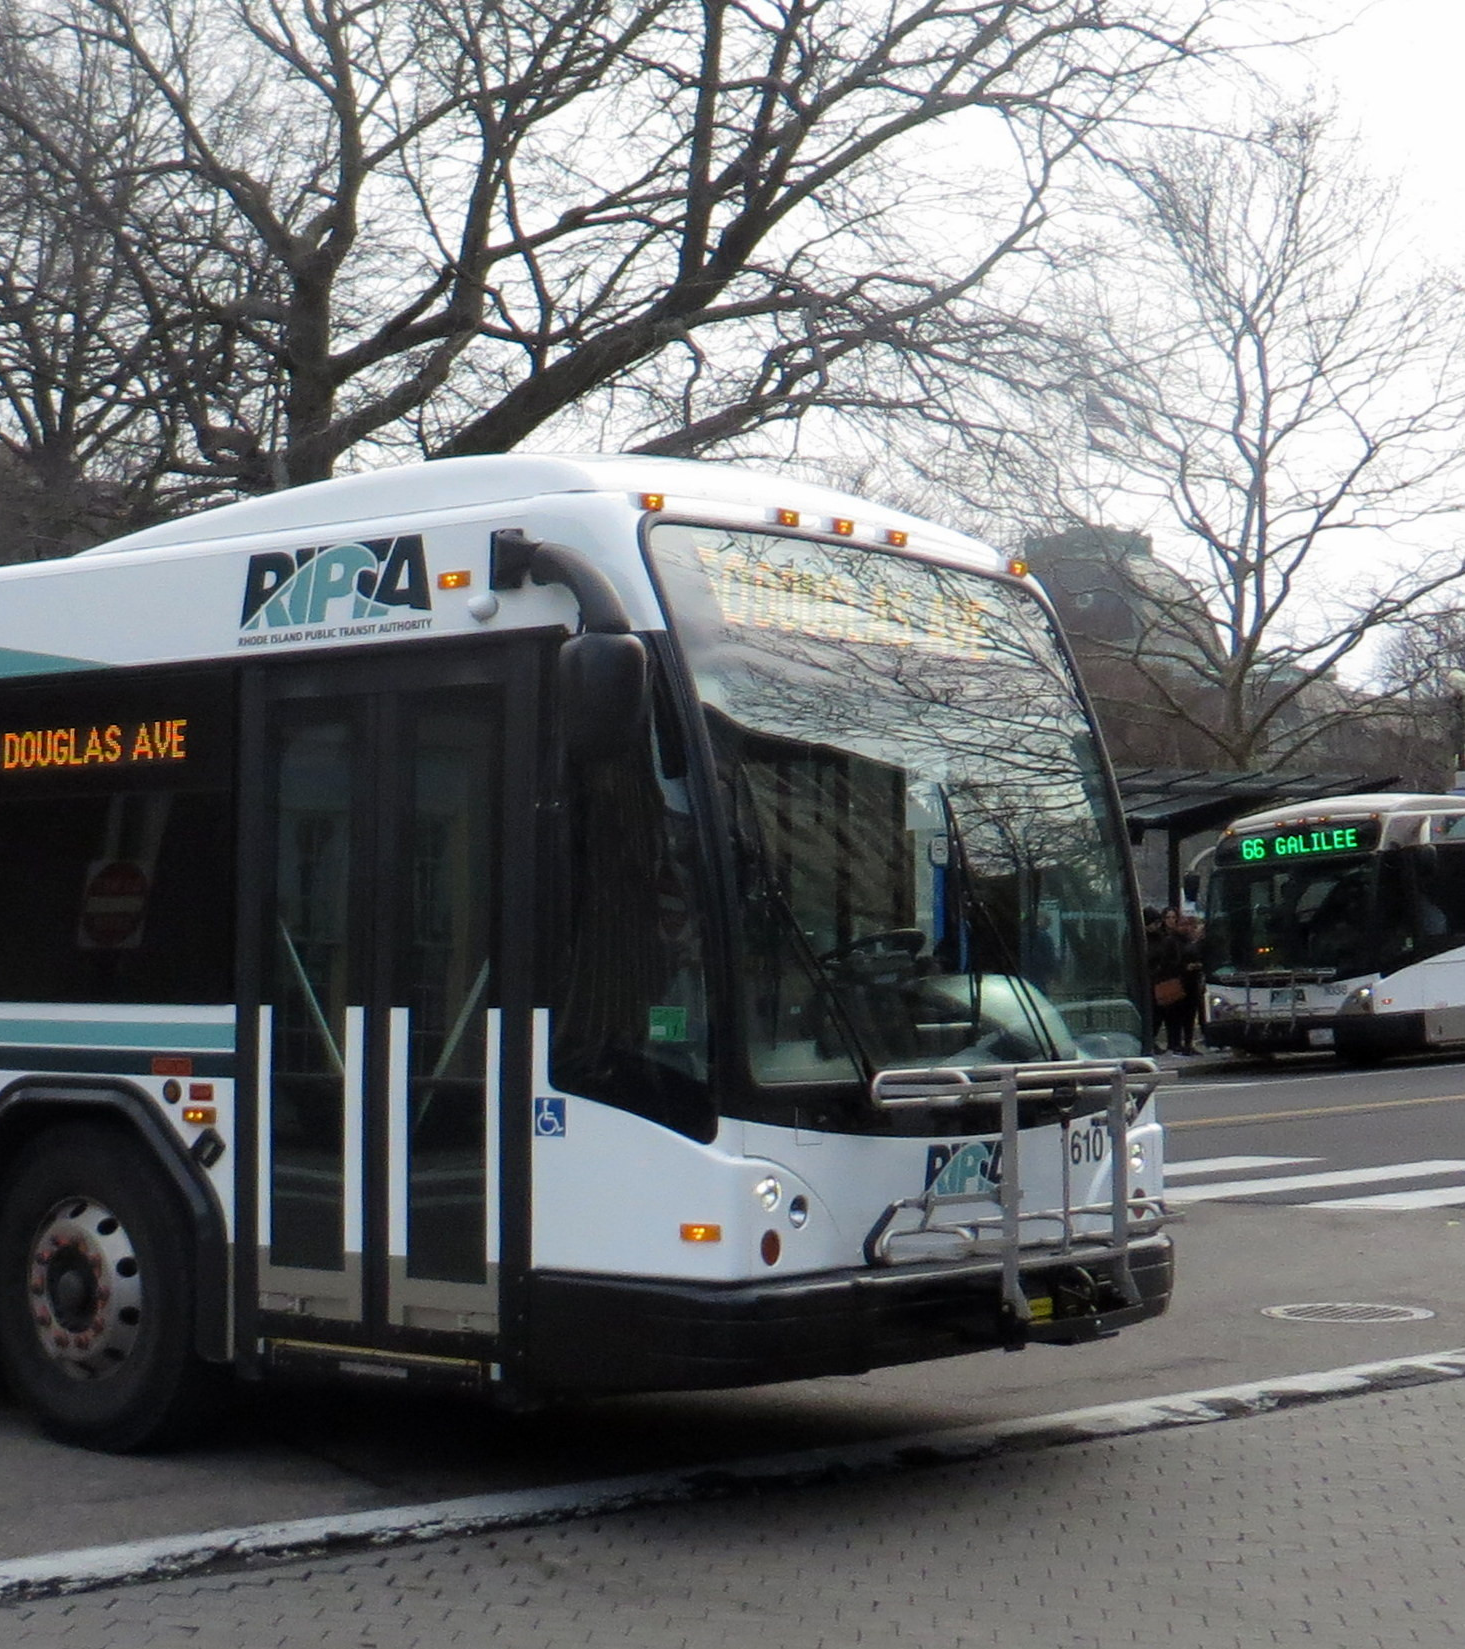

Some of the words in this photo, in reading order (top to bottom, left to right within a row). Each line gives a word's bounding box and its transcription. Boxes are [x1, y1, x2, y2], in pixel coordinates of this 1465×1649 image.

[240, 534, 432, 631] RIPTA
[237, 634, 268, 647] RHODE
[270, 631, 303, 644] ISLAND
[304, 627, 337, 641] PUBLIC
[339, 624, 376, 637] TRANSIT
[377, 618, 433, 634] AUTHORITY
[3, 725, 123, 769] DOUGLAS
[132, 719, 188, 761] AVE
[1241, 838, 1266, 861] 66
[1274, 828, 1358, 856] GALILEE
